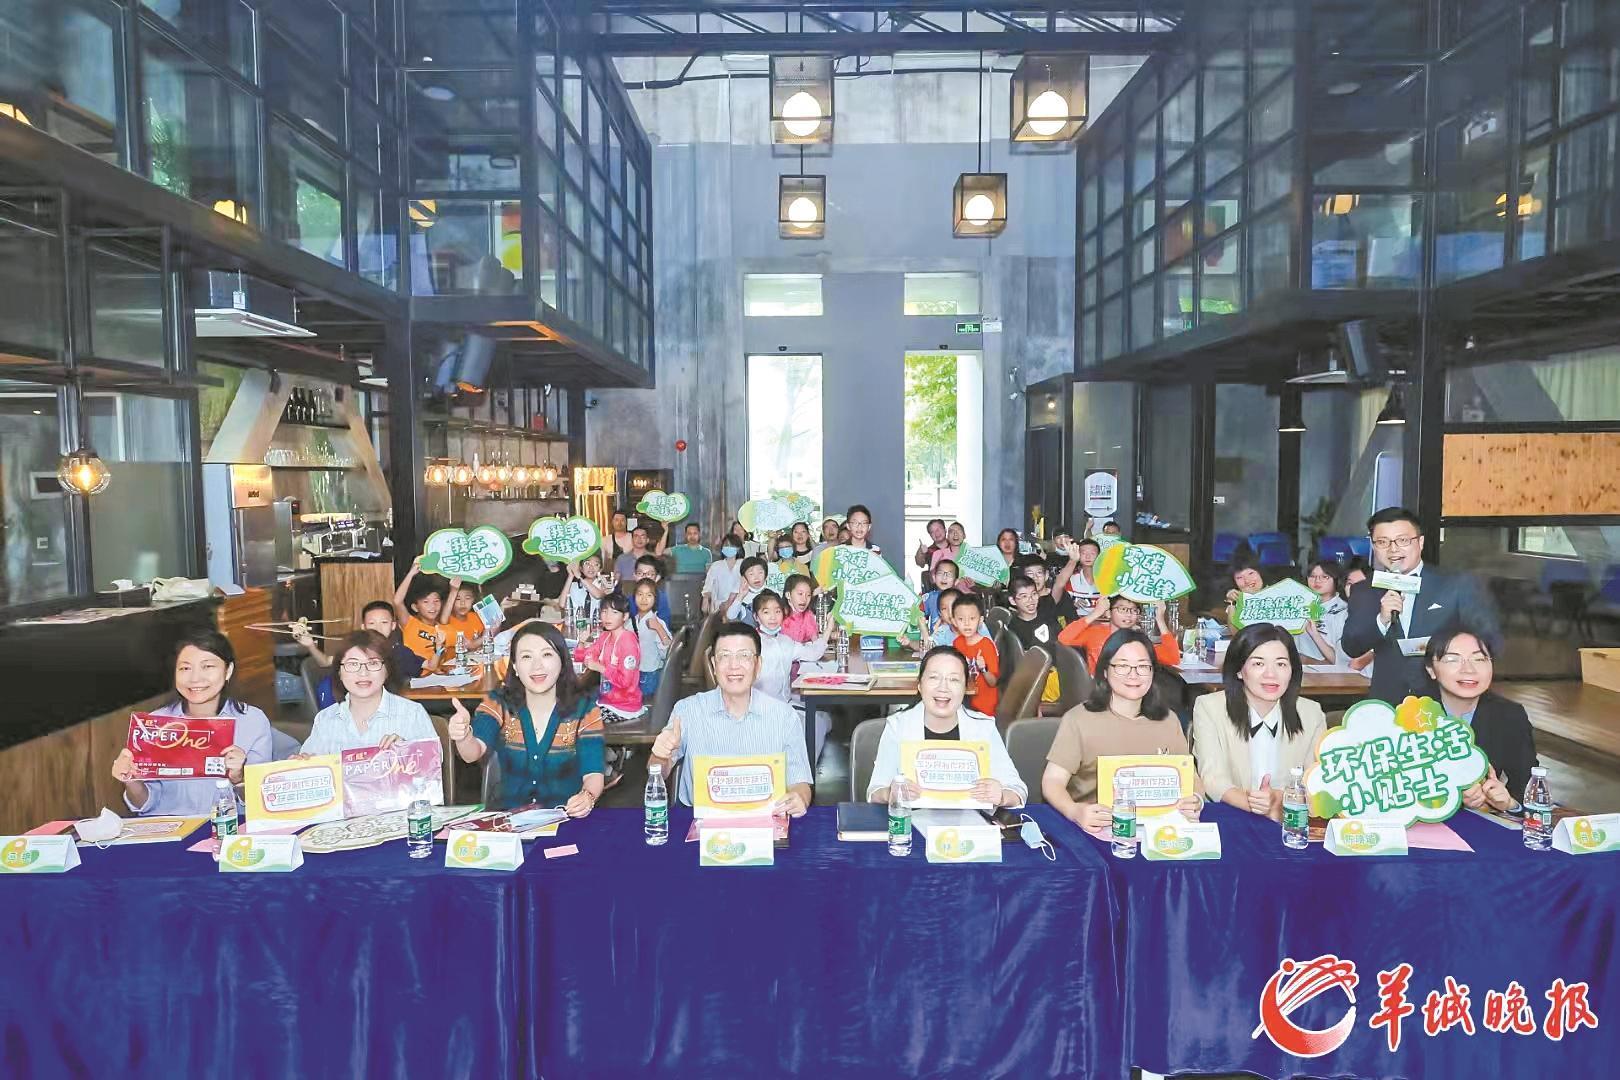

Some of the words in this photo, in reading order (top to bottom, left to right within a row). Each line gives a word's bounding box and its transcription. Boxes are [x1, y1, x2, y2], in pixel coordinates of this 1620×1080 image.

[547, 523, 581, 540] 我手
[448, 535, 489, 555] 我手
[541, 538, 589, 555] 写我心
[441, 552, 499, 573] 写我心
[833, 547, 870, 569] 零碳
[1123, 547, 1167, 576] 零碳
[1115, 571, 1177, 601] 小先锋
[844, 589, 906, 609] 环境保护
[1242, 595, 1306, 611] 环境保护
[838, 602, 912, 623] 从你我做起
[1238, 606, 1313, 622] 从你我做起
[1320, 722, 1472, 783] 环保生活
[1339, 765, 1449, 815] 小贴士
